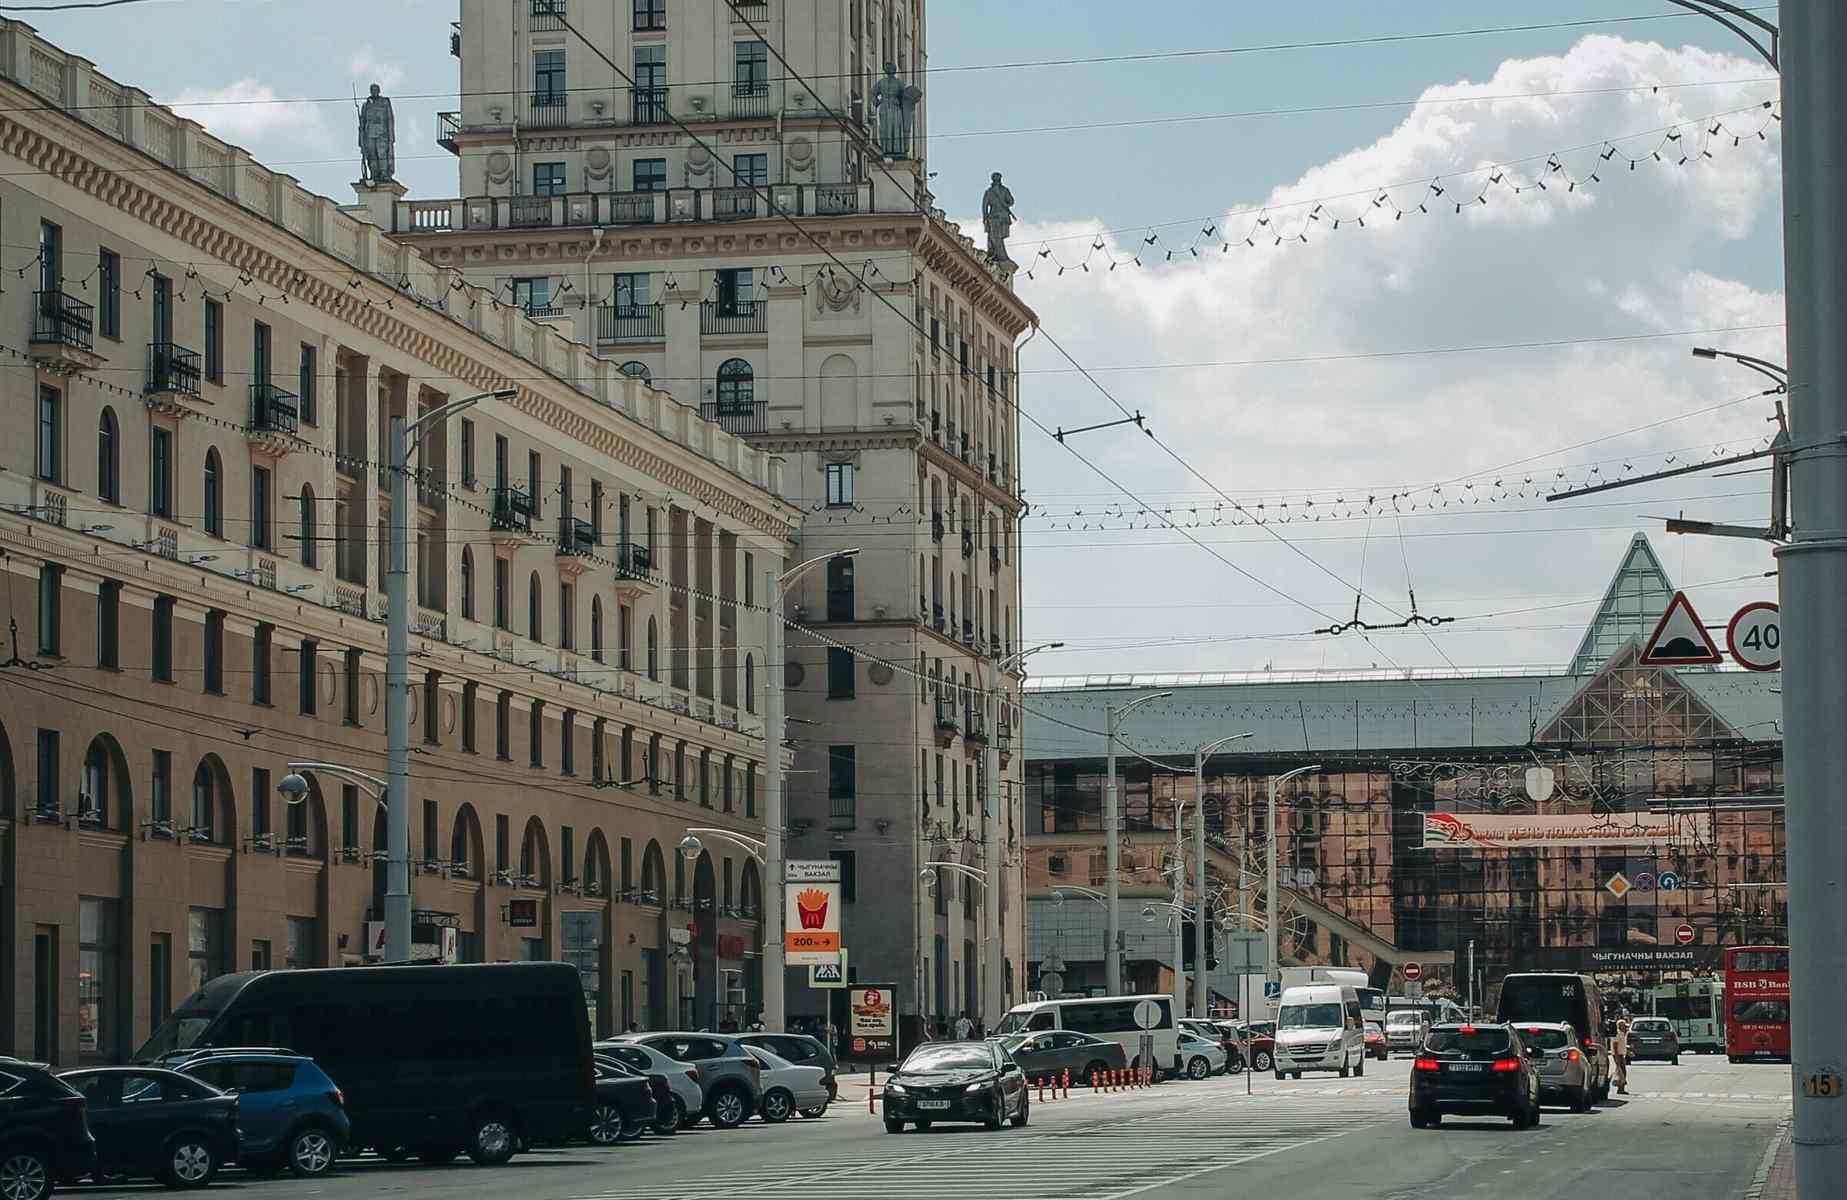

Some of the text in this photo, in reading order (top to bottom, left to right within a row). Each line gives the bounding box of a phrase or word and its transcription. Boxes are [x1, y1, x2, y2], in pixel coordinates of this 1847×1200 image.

[1743, 624, 1780, 650] 40
[1447, 823, 1472, 841] 25
[1508, 826, 1544, 840] ДЕНЬ
[793, 937, 813, 946] 200
[1592, 951, 1693, 960] ЧЫГУНАЧНЫ ВАКЗАЛ
[1811, 1073, 1831, 1095] 15
